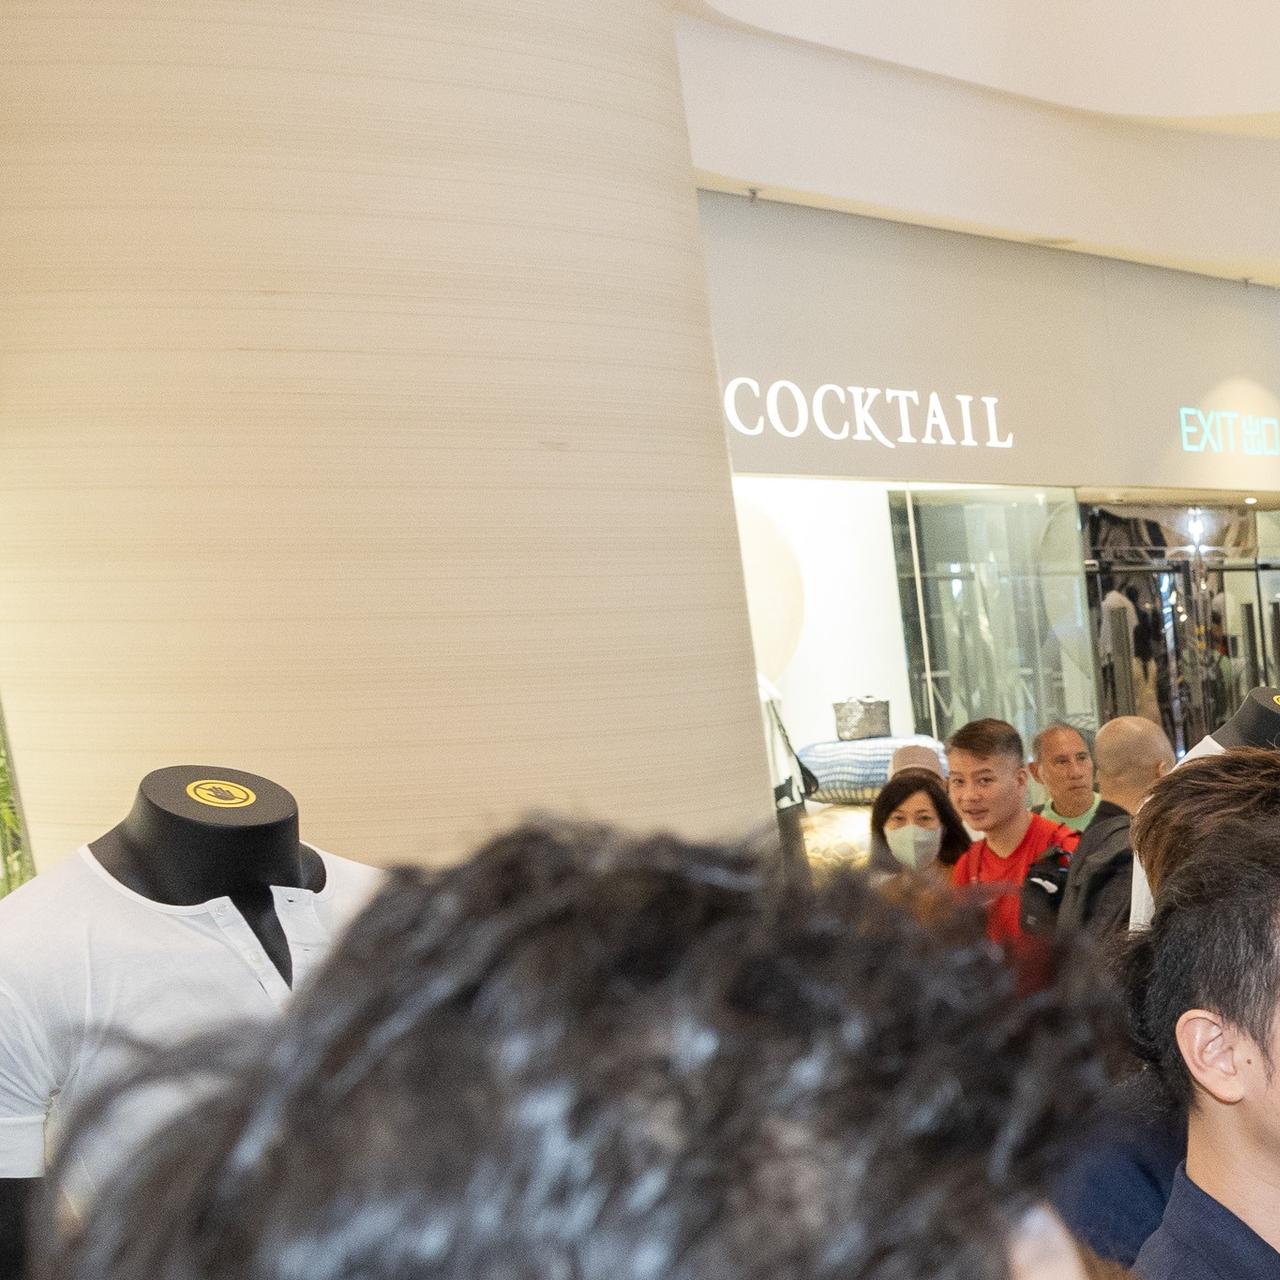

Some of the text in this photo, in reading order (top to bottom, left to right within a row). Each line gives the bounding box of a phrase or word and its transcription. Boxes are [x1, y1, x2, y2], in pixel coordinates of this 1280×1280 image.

[724, 376, 1014, 449] COCKTAIL
[1179, 407, 1280, 456] EXIT 出口
